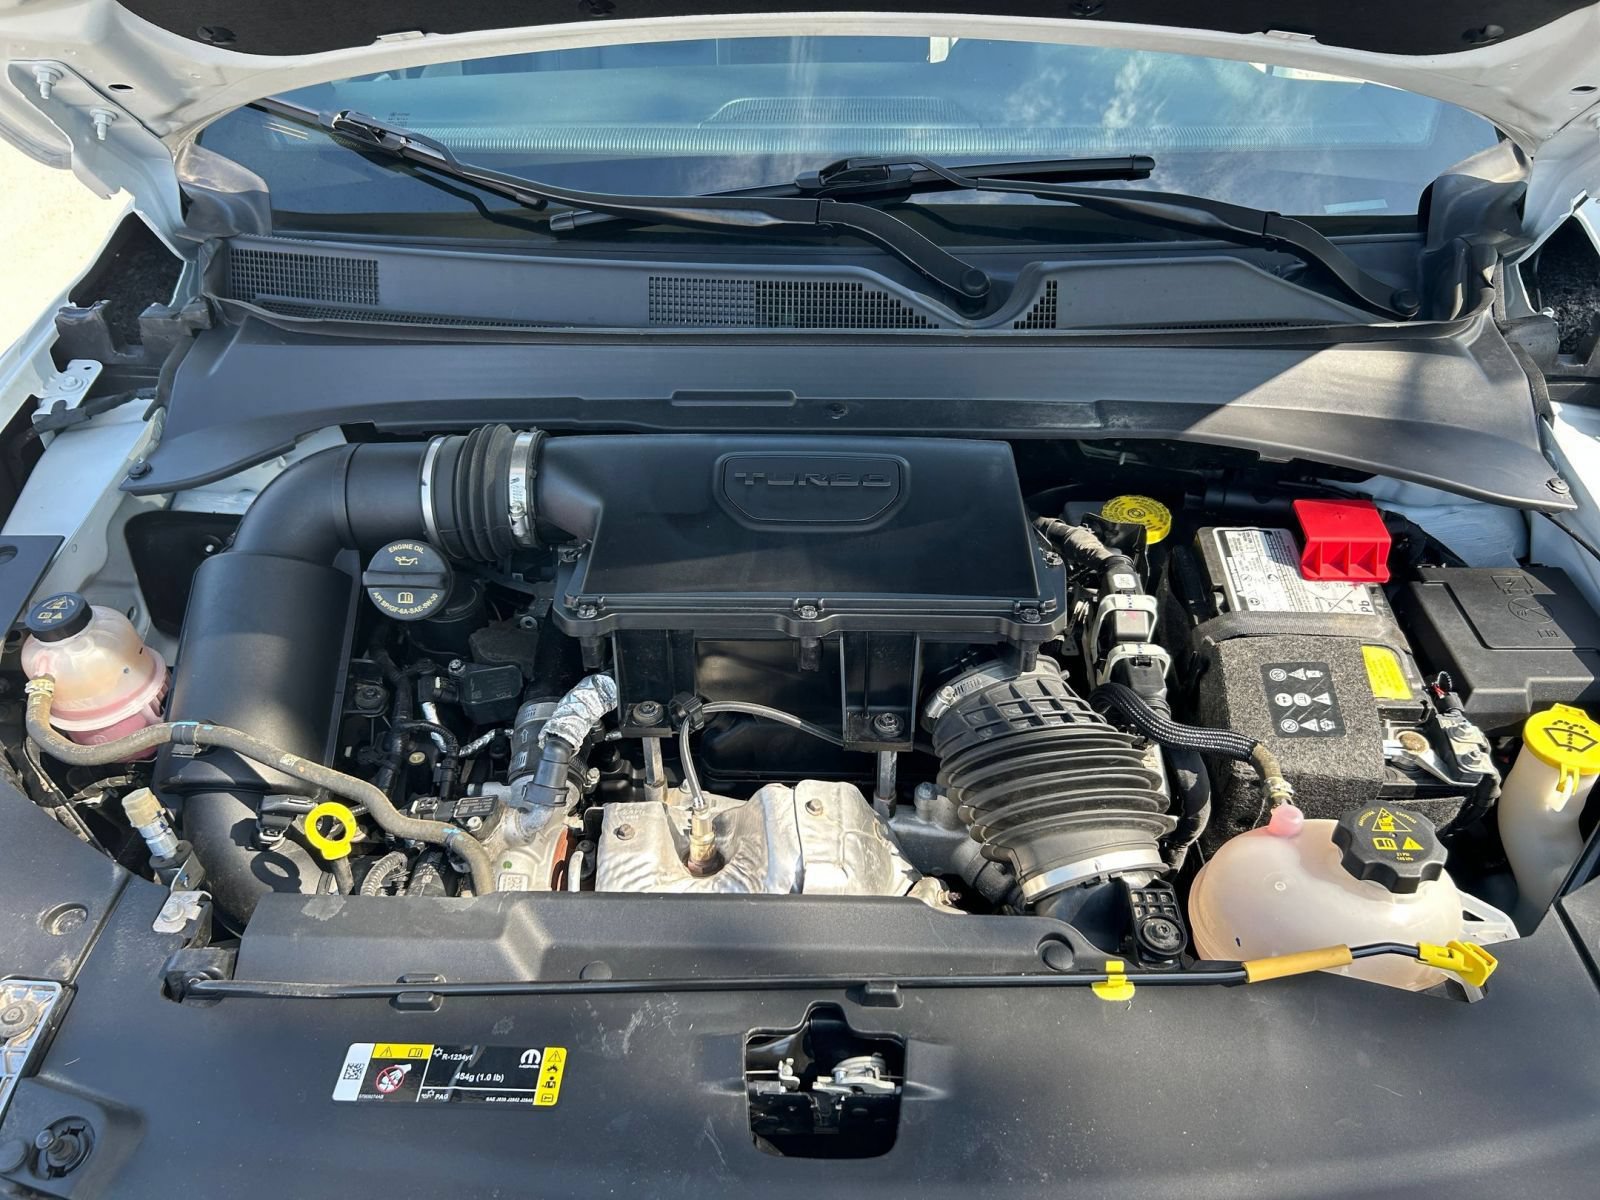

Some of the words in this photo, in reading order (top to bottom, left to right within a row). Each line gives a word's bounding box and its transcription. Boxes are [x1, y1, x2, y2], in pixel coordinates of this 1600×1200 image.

[734, 472, 891, 487] TURBO
[389, 544, 412, 552] ENGINE
[414, 545, 424, 553] OIL
[455, 1072, 475, 1083] 454g
[476, 1073, 492, 1083] (1.0
[493, 1073, 505, 1083] lb)
